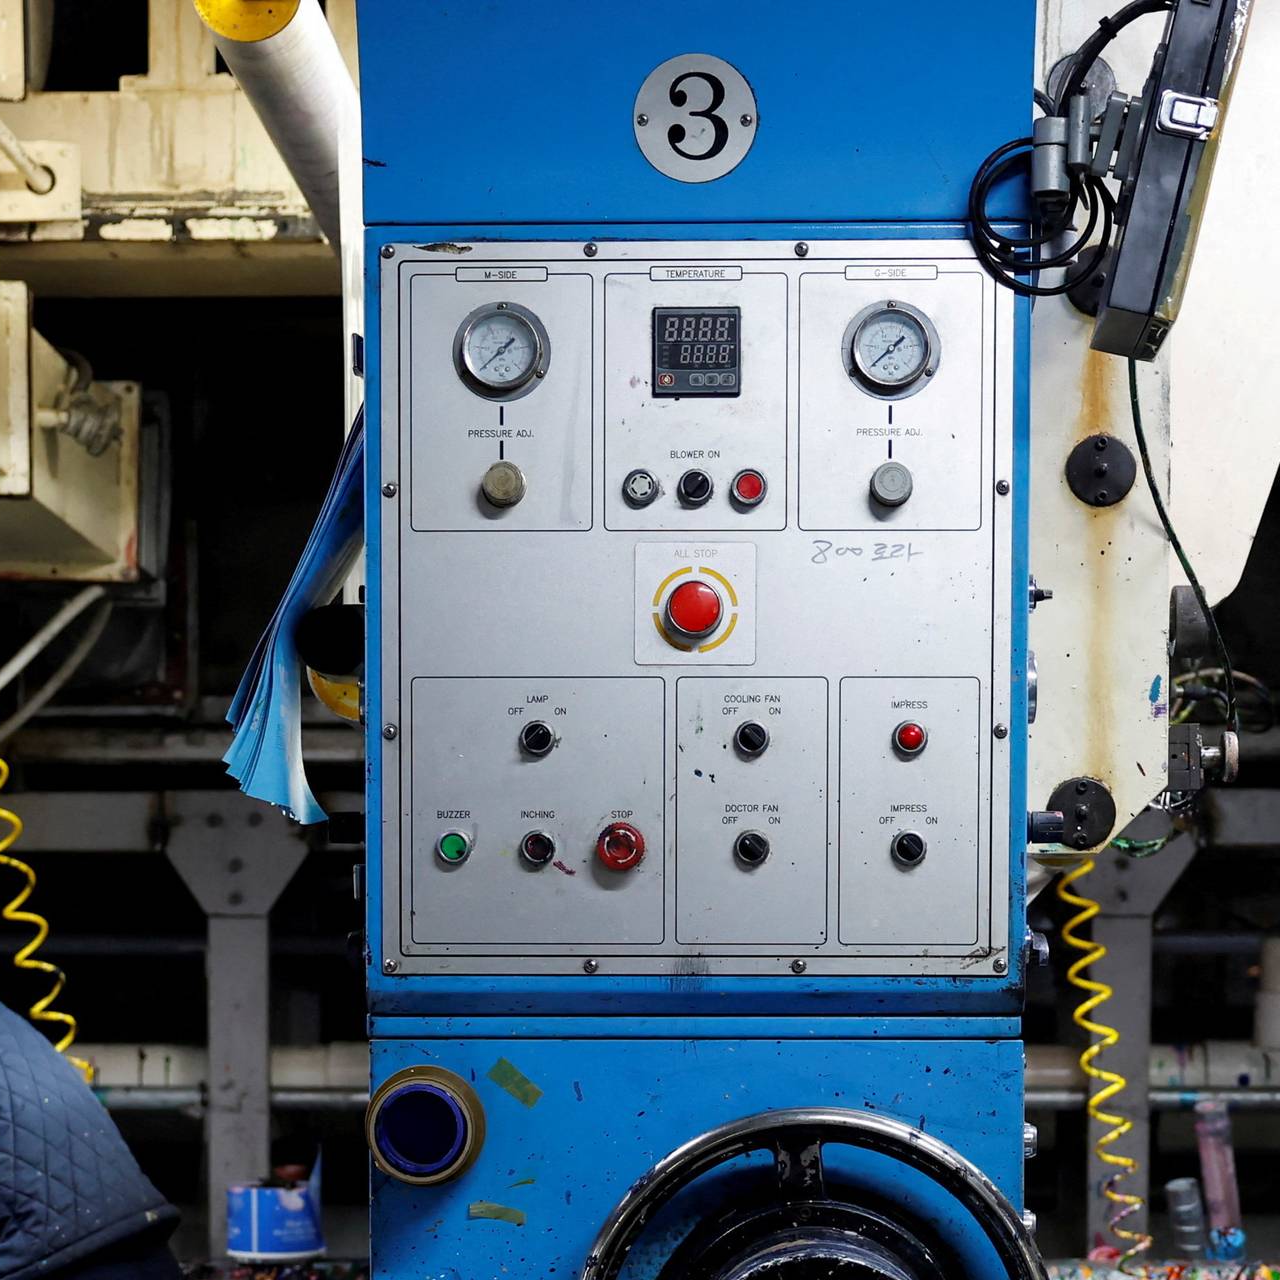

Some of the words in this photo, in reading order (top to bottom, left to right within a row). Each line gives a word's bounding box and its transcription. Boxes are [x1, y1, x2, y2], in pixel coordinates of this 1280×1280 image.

[668, 71, 728, 161] 3
[482, 270, 518, 280] M-SIDE
[664, 269, 727, 279] TEMPERATURE
[873, 268, 908, 278] G-SIDE
[467, 429, 516, 438] PRESSURE
[515, 429, 536, 438] ADJ.
[856, 428, 904, 437] PRESSURE
[903, 428, 925, 437] ADJ.
[669, 449, 706, 459] BLOWER
[706, 449, 722, 459] ON
[673, 549, 692, 558] ALL
[692, 549, 719, 558] STOP
[526, 695, 549, 703] LAMP
[723, 695, 761, 703] COOLING
[891, 700, 928, 709] IMPRESS
[507, 707, 525, 715] OFF
[721, 707, 739, 715] OFF
[768, 707, 782, 715] ON
[724, 804, 759, 812] DOCTOR
[890, 804, 928, 812] IMPRESS
[436, 811, 471, 819] BUZZER
[610, 810, 634, 818] STOP
[721, 816, 739, 824] OFF
